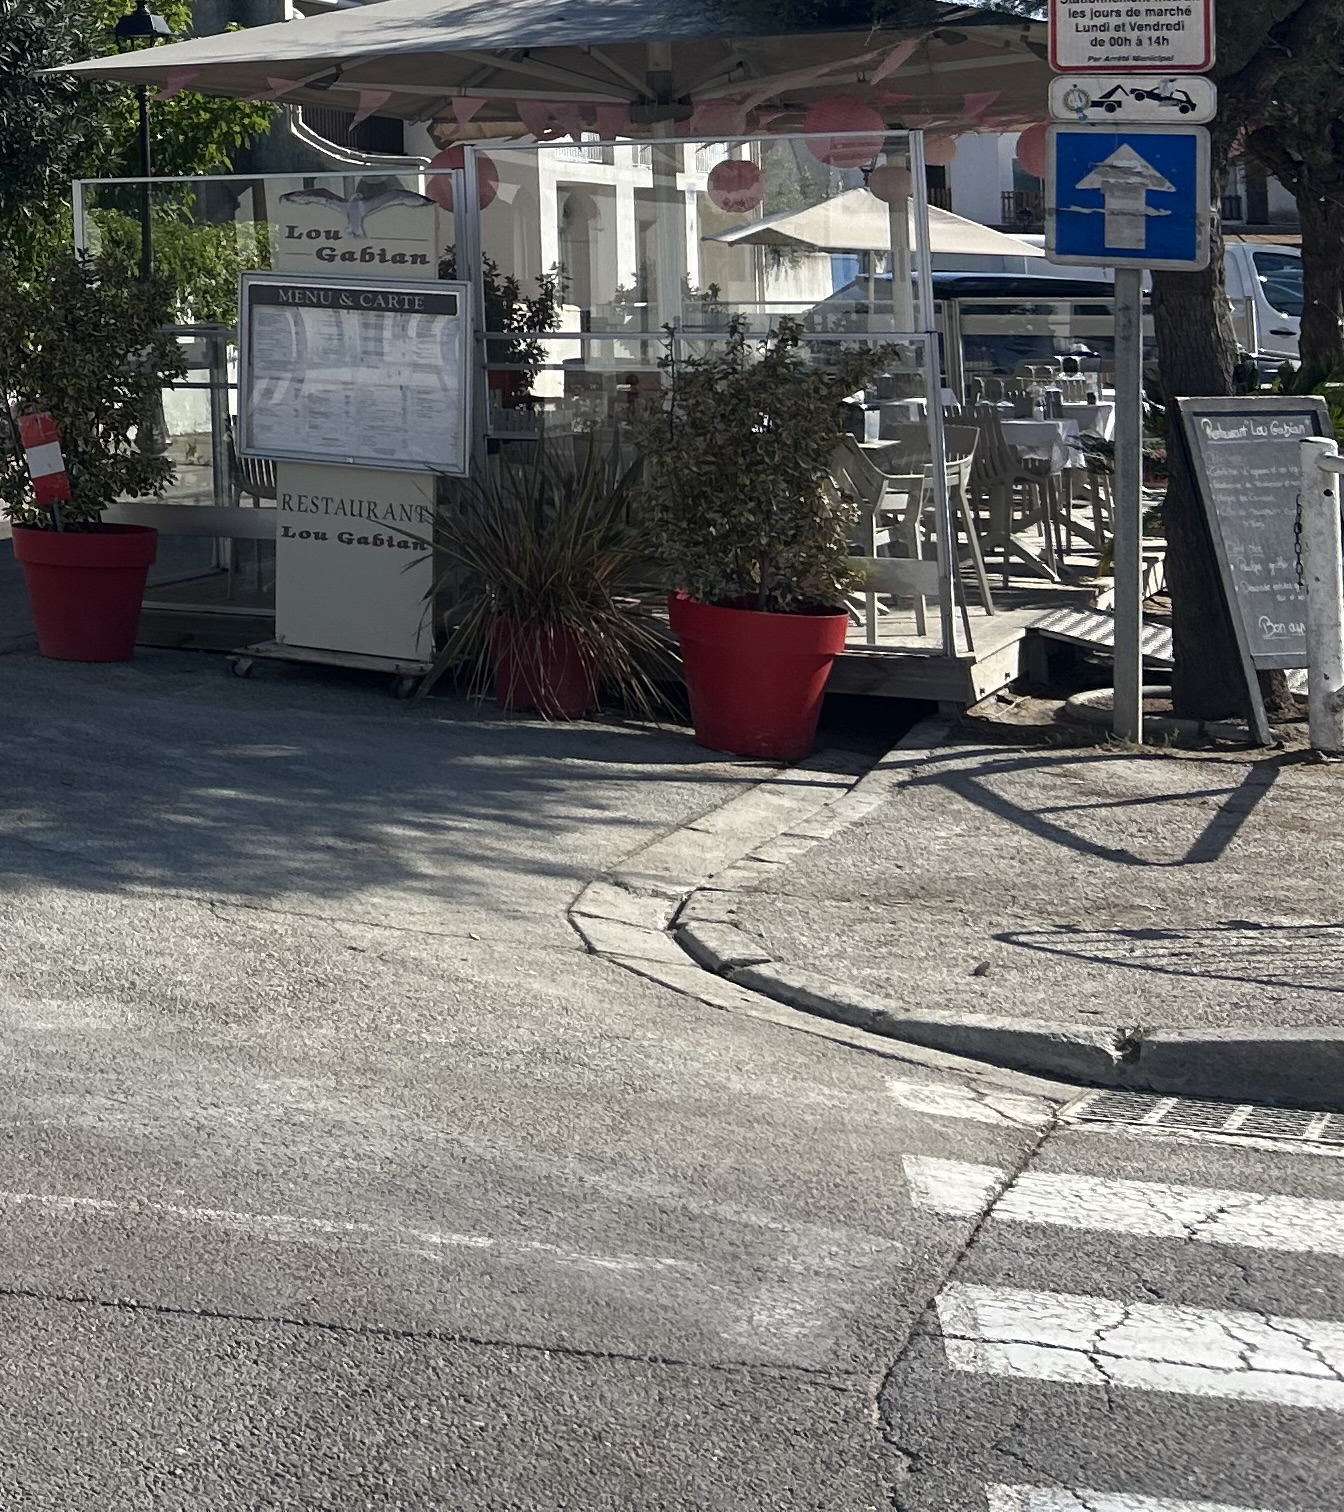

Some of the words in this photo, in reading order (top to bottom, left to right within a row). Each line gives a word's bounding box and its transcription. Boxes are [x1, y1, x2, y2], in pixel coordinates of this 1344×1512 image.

[1068, 8, 1086, 19] les
[1090, 7, 1122, 21] jours
[1126, 6, 1141, 18] de
[1145, 4, 1192, 17] marché
[1075, 22, 1110, 33] Lundi
[1114, 22, 1126, 33] et
[1129, 20, 1185, 32] Vendredi
[1090, 37, 1105, 47] de
[1109, 36, 1132, 47] 00h
[1135, 35, 1143, 47] à
[1148, 35, 1170, 47] 14h
[284, 225, 343, 241] Lou
[315, 246, 431, 266] Gabian
[278, 289, 333, 304] MENU
[339, 292, 354, 307] &
[359, 293, 425, 310] CARTE
[281, 493, 429, 524] RESTAURANT
[280, 525, 330, 542] Lou
[336, 531, 429, 551] Gabian
